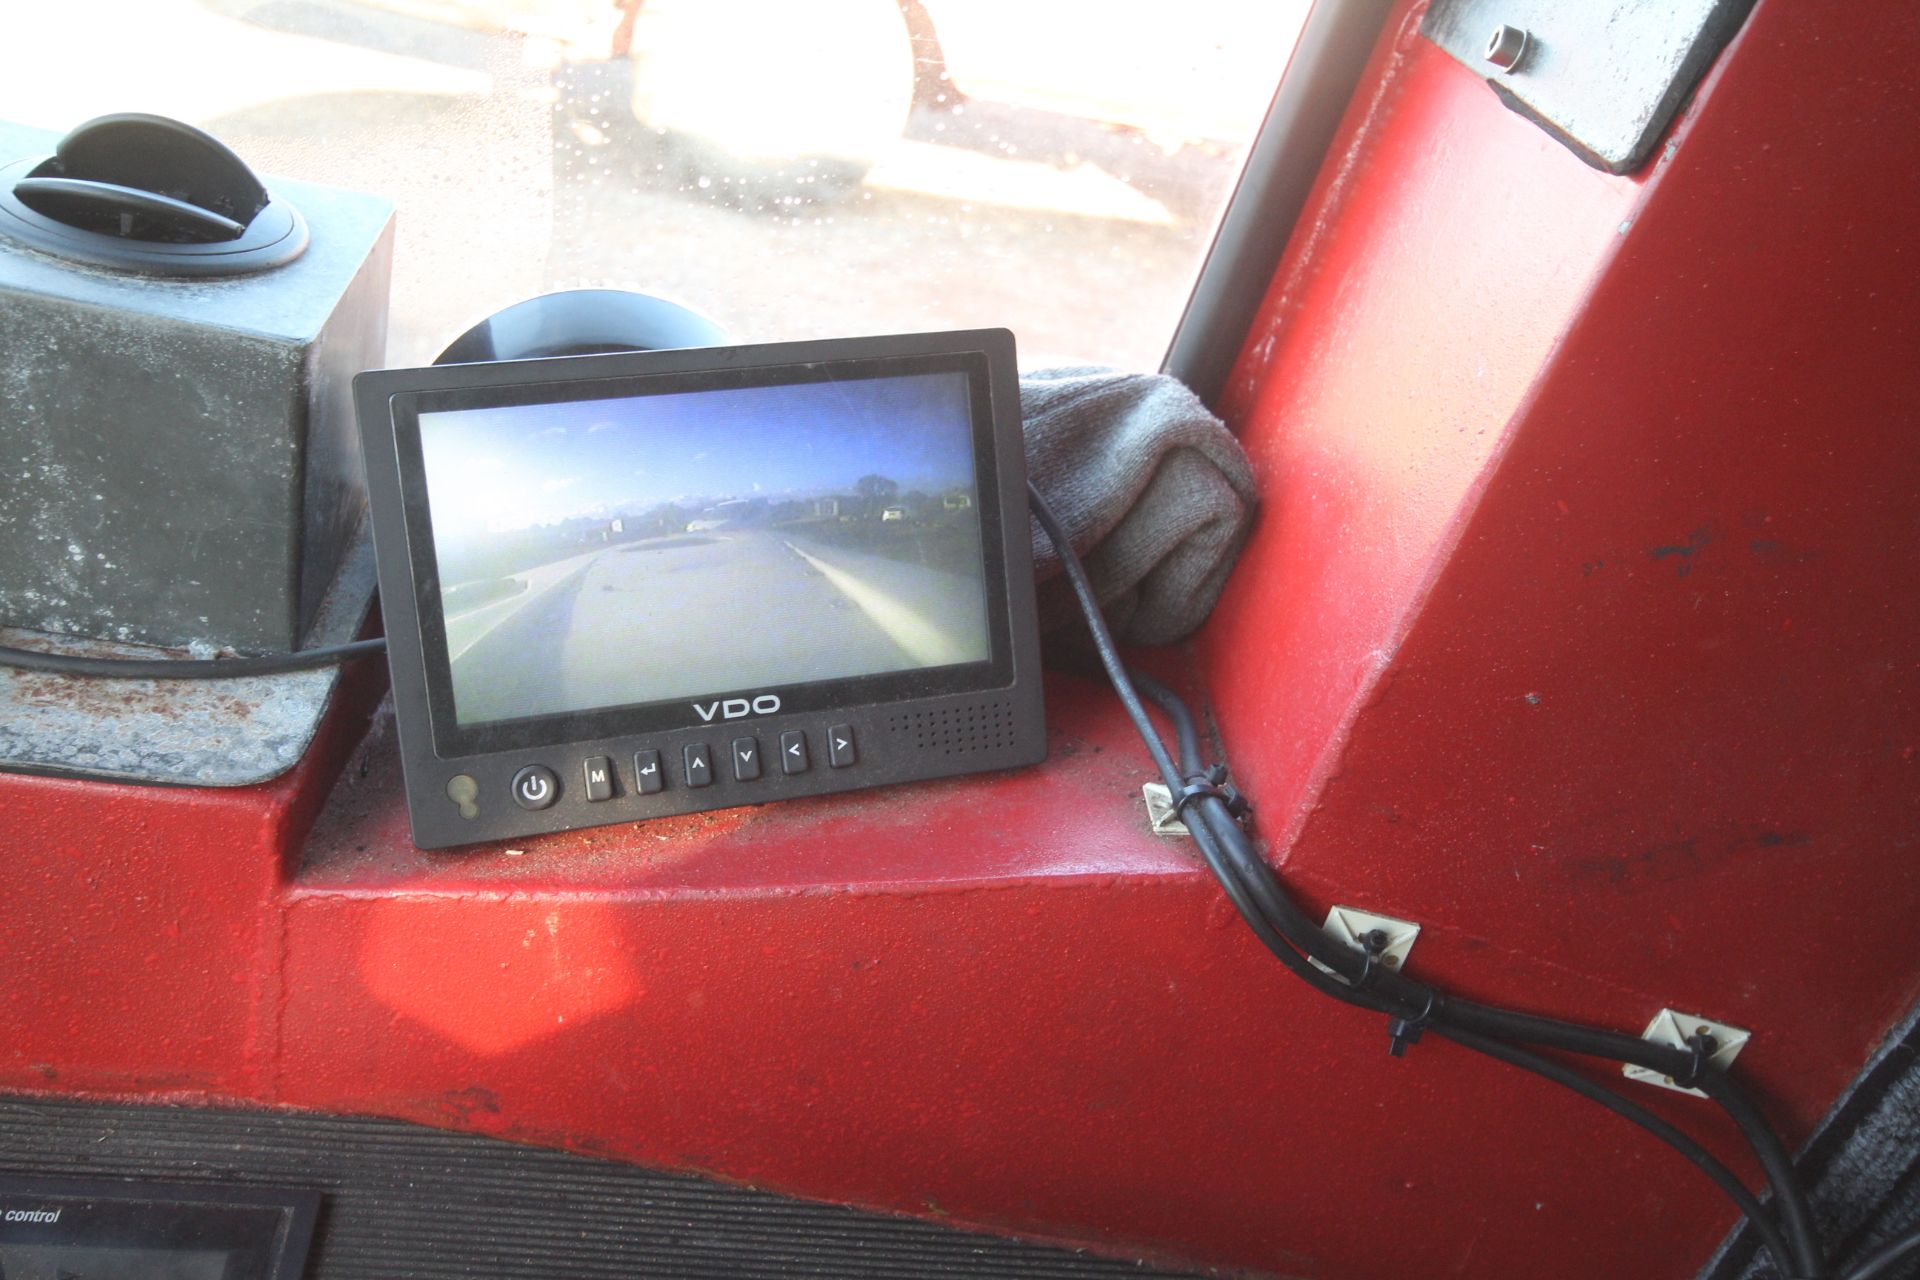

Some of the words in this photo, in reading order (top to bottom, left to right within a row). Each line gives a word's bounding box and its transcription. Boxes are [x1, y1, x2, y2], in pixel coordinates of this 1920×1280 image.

[692, 694, 781, 721] VDO
[591, 769, 605, 783] M
[5, 1208, 62, 1223] control
